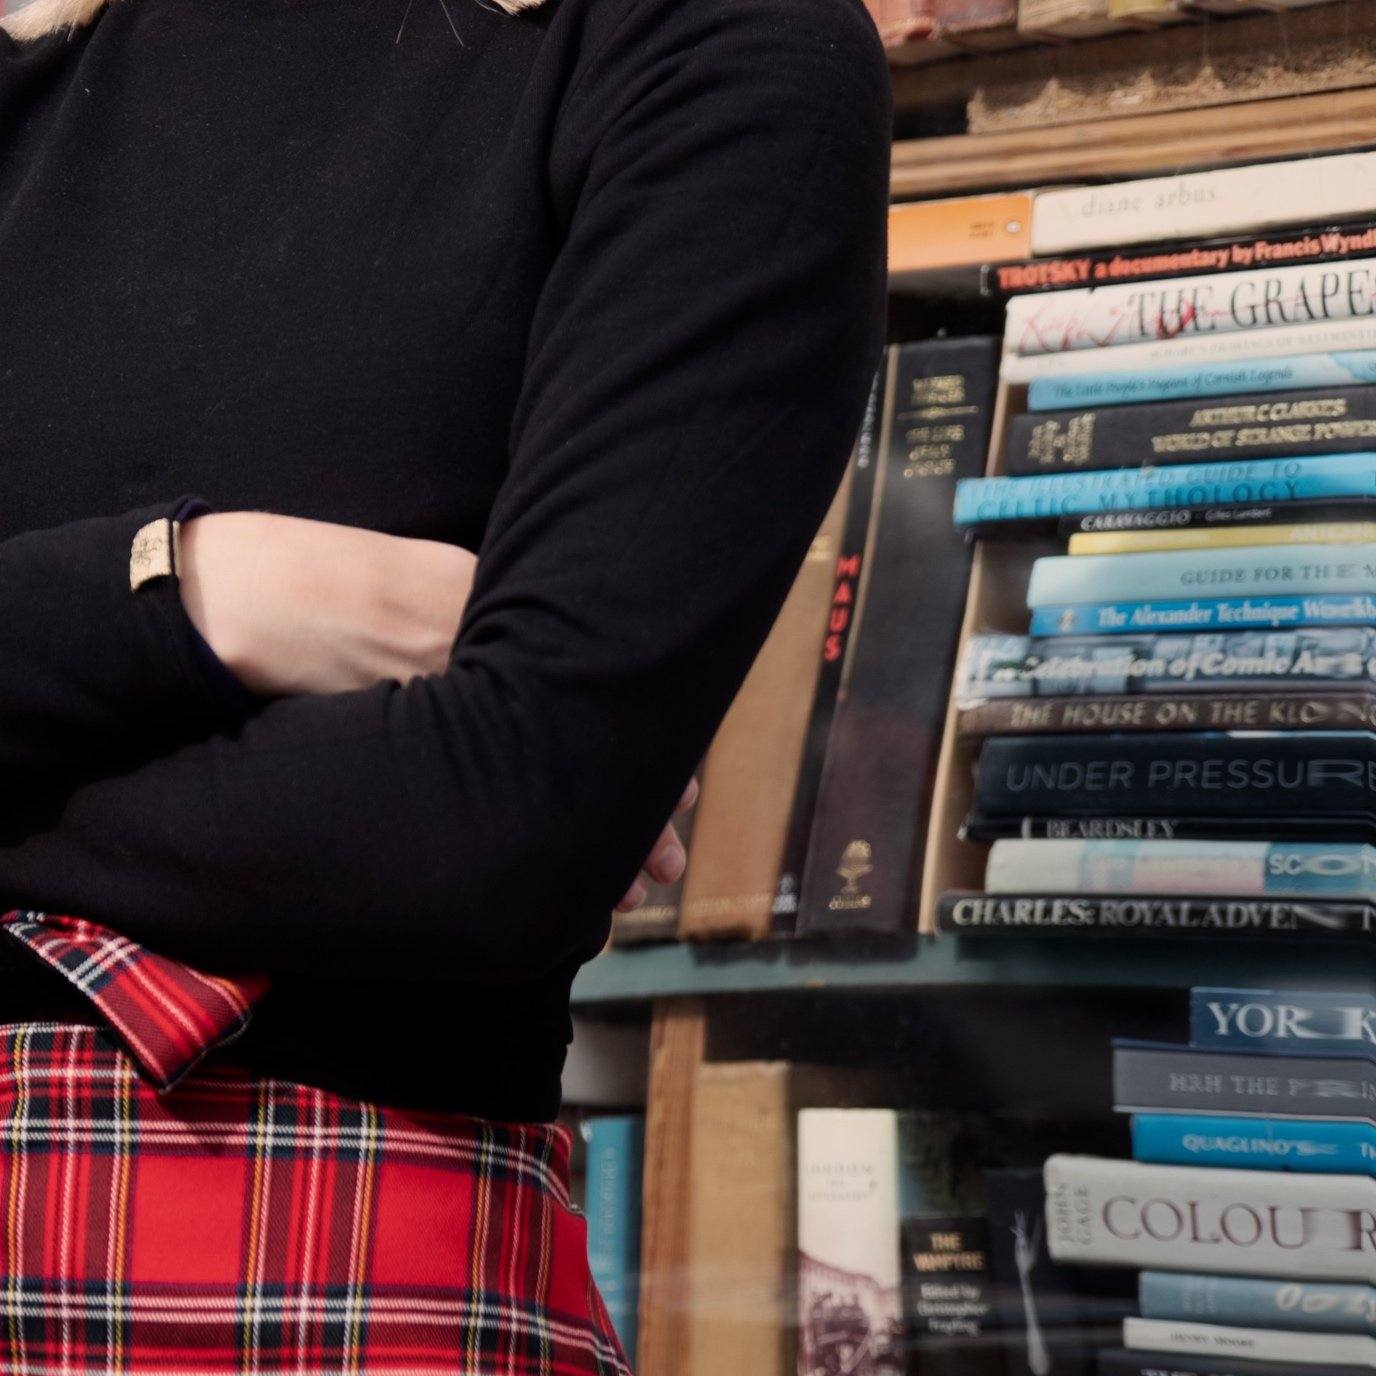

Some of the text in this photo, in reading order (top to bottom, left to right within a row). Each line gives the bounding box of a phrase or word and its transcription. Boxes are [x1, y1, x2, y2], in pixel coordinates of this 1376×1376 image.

[1082, 180, 1220, 219] diane arbus
[997, 260, 1091, 292] TROTSKY
[1107, 244, 1231, 278] documentary
[1231, 241, 1255, 267] by
[1254, 234, 1322, 264] Francis
[1129, 268, 1376, 340] THE GRAPE
[1184, 462, 1255, 485] GUIDE
[1271, 461, 1303, 479] TO
[977, 479, 1299, 523] CELTIC MYTHOLOGY
[1080, 508, 1193, 533] CARAVAGGIO
[1180, 568, 1247, 588] GUIDE
[1252, 565, 1294, 584] FOR
[824, 553, 862, 662] MAUS
[1097, 604, 1128, 628] The
[1129, 600, 1214, 626] Alexander
[1217, 598, 1299, 629] Technique
[1167, 651, 1197, 682] of
[1198, 651, 1291, 678] Comic
[1010, 699, 1259, 727] THE HOUSE ON THE
[1006, 760, 1134, 793] UNDER
[1046, 817, 1177, 840] BEARDSLEY
[1100, 900, 1201, 927] ROYAL
[928, 1232, 963, 1251] THE
